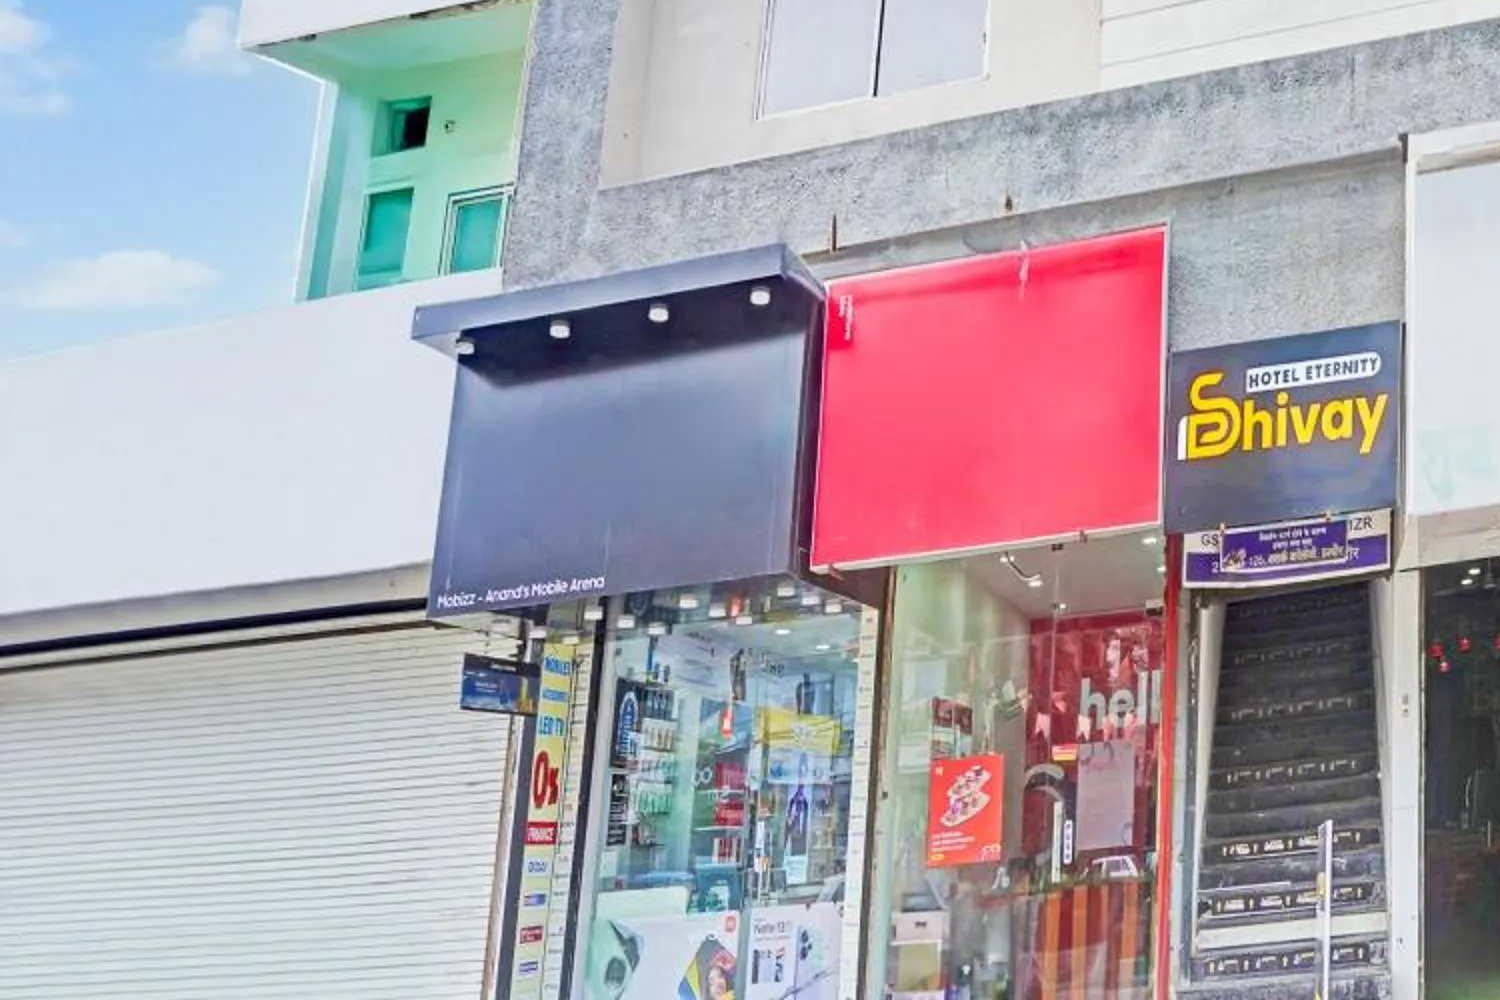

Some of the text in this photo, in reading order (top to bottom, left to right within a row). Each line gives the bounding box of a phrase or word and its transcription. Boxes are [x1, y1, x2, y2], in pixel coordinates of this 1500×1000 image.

[1249, 357, 1379, 388] HOTEL ETERNITY
[1178, 372, 1389, 460] Shivay
[437, 592, 475, 609] Mobizz
[486, 584, 529, 603] Anand's
[531, 579, 568, 597] Mobile
[570, 576, 605, 592] Arena
